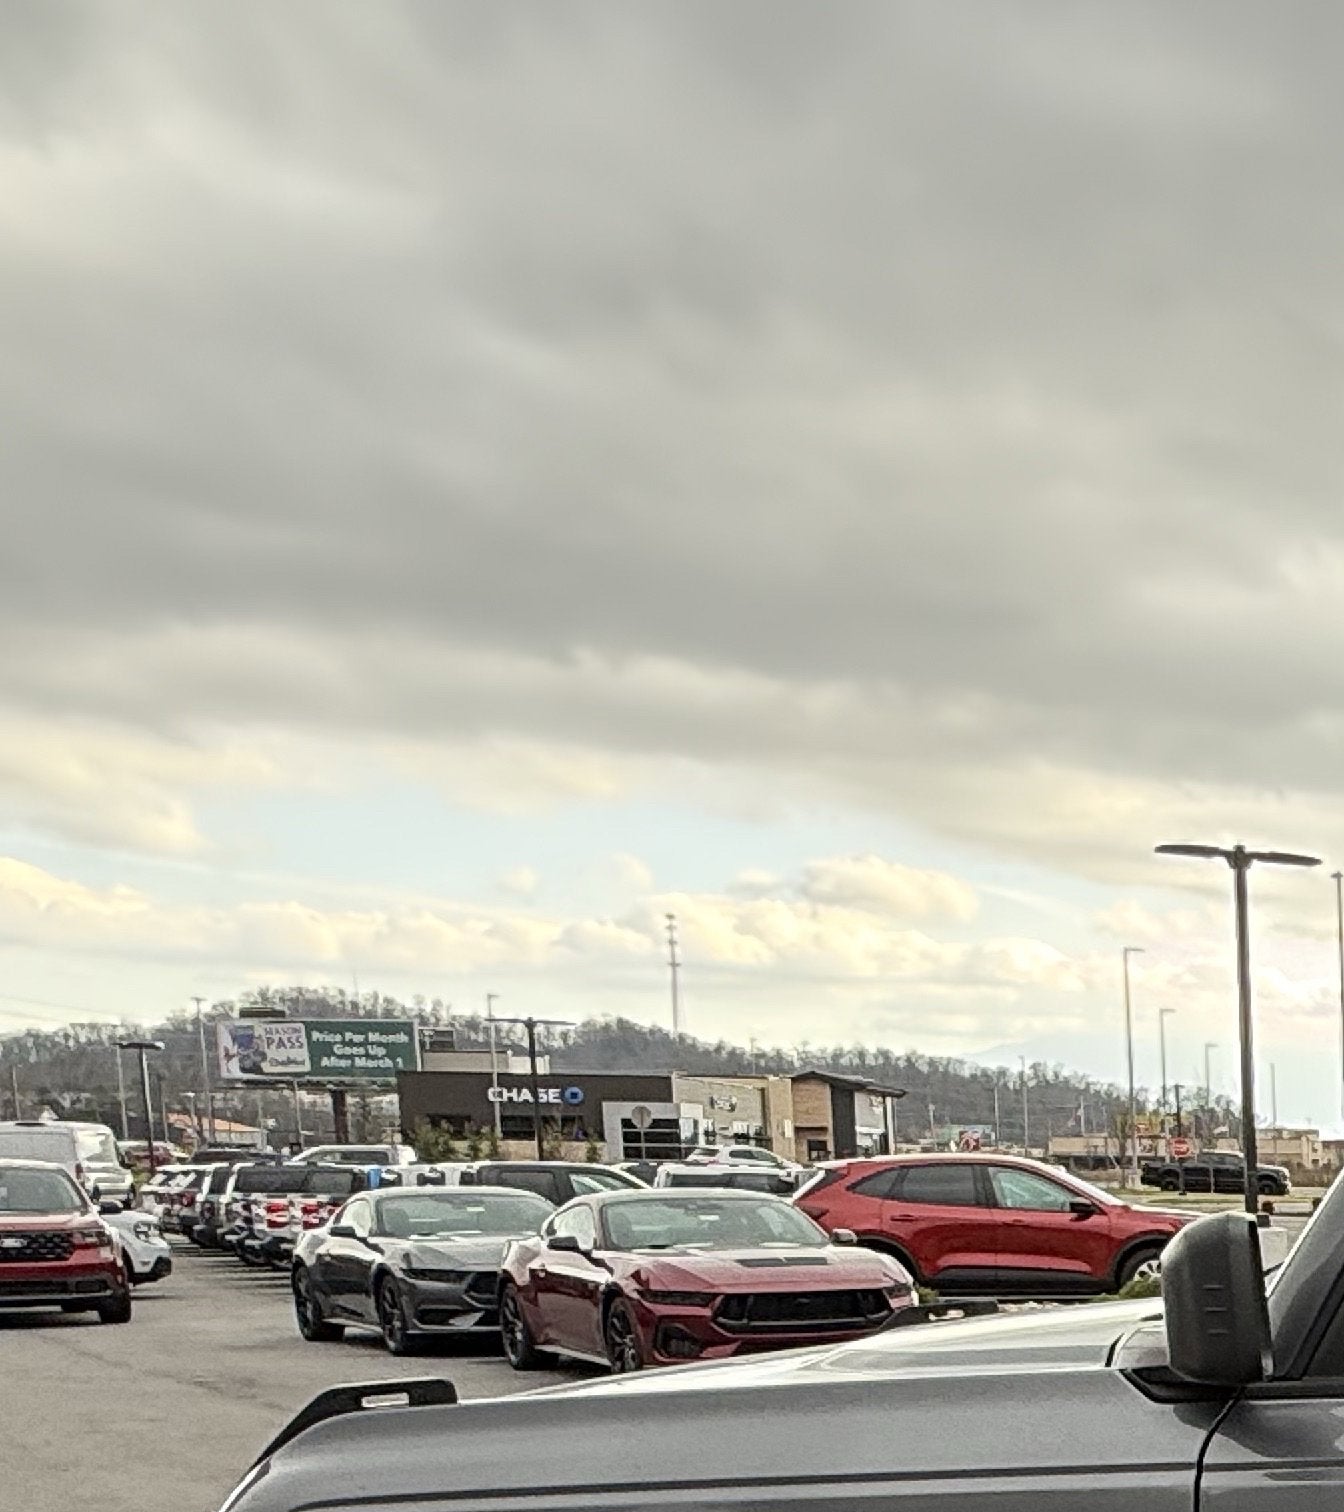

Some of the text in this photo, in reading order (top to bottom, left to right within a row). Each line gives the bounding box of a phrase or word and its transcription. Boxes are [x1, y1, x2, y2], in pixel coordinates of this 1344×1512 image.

[265, 1035, 304, 1050] PASS
[311, 1031, 409, 1043] Price Per Month
[333, 1044, 388, 1058] Goes Up
[320, 1056, 404, 1069] After March 1
[487, 1086, 563, 1103] CHASE
